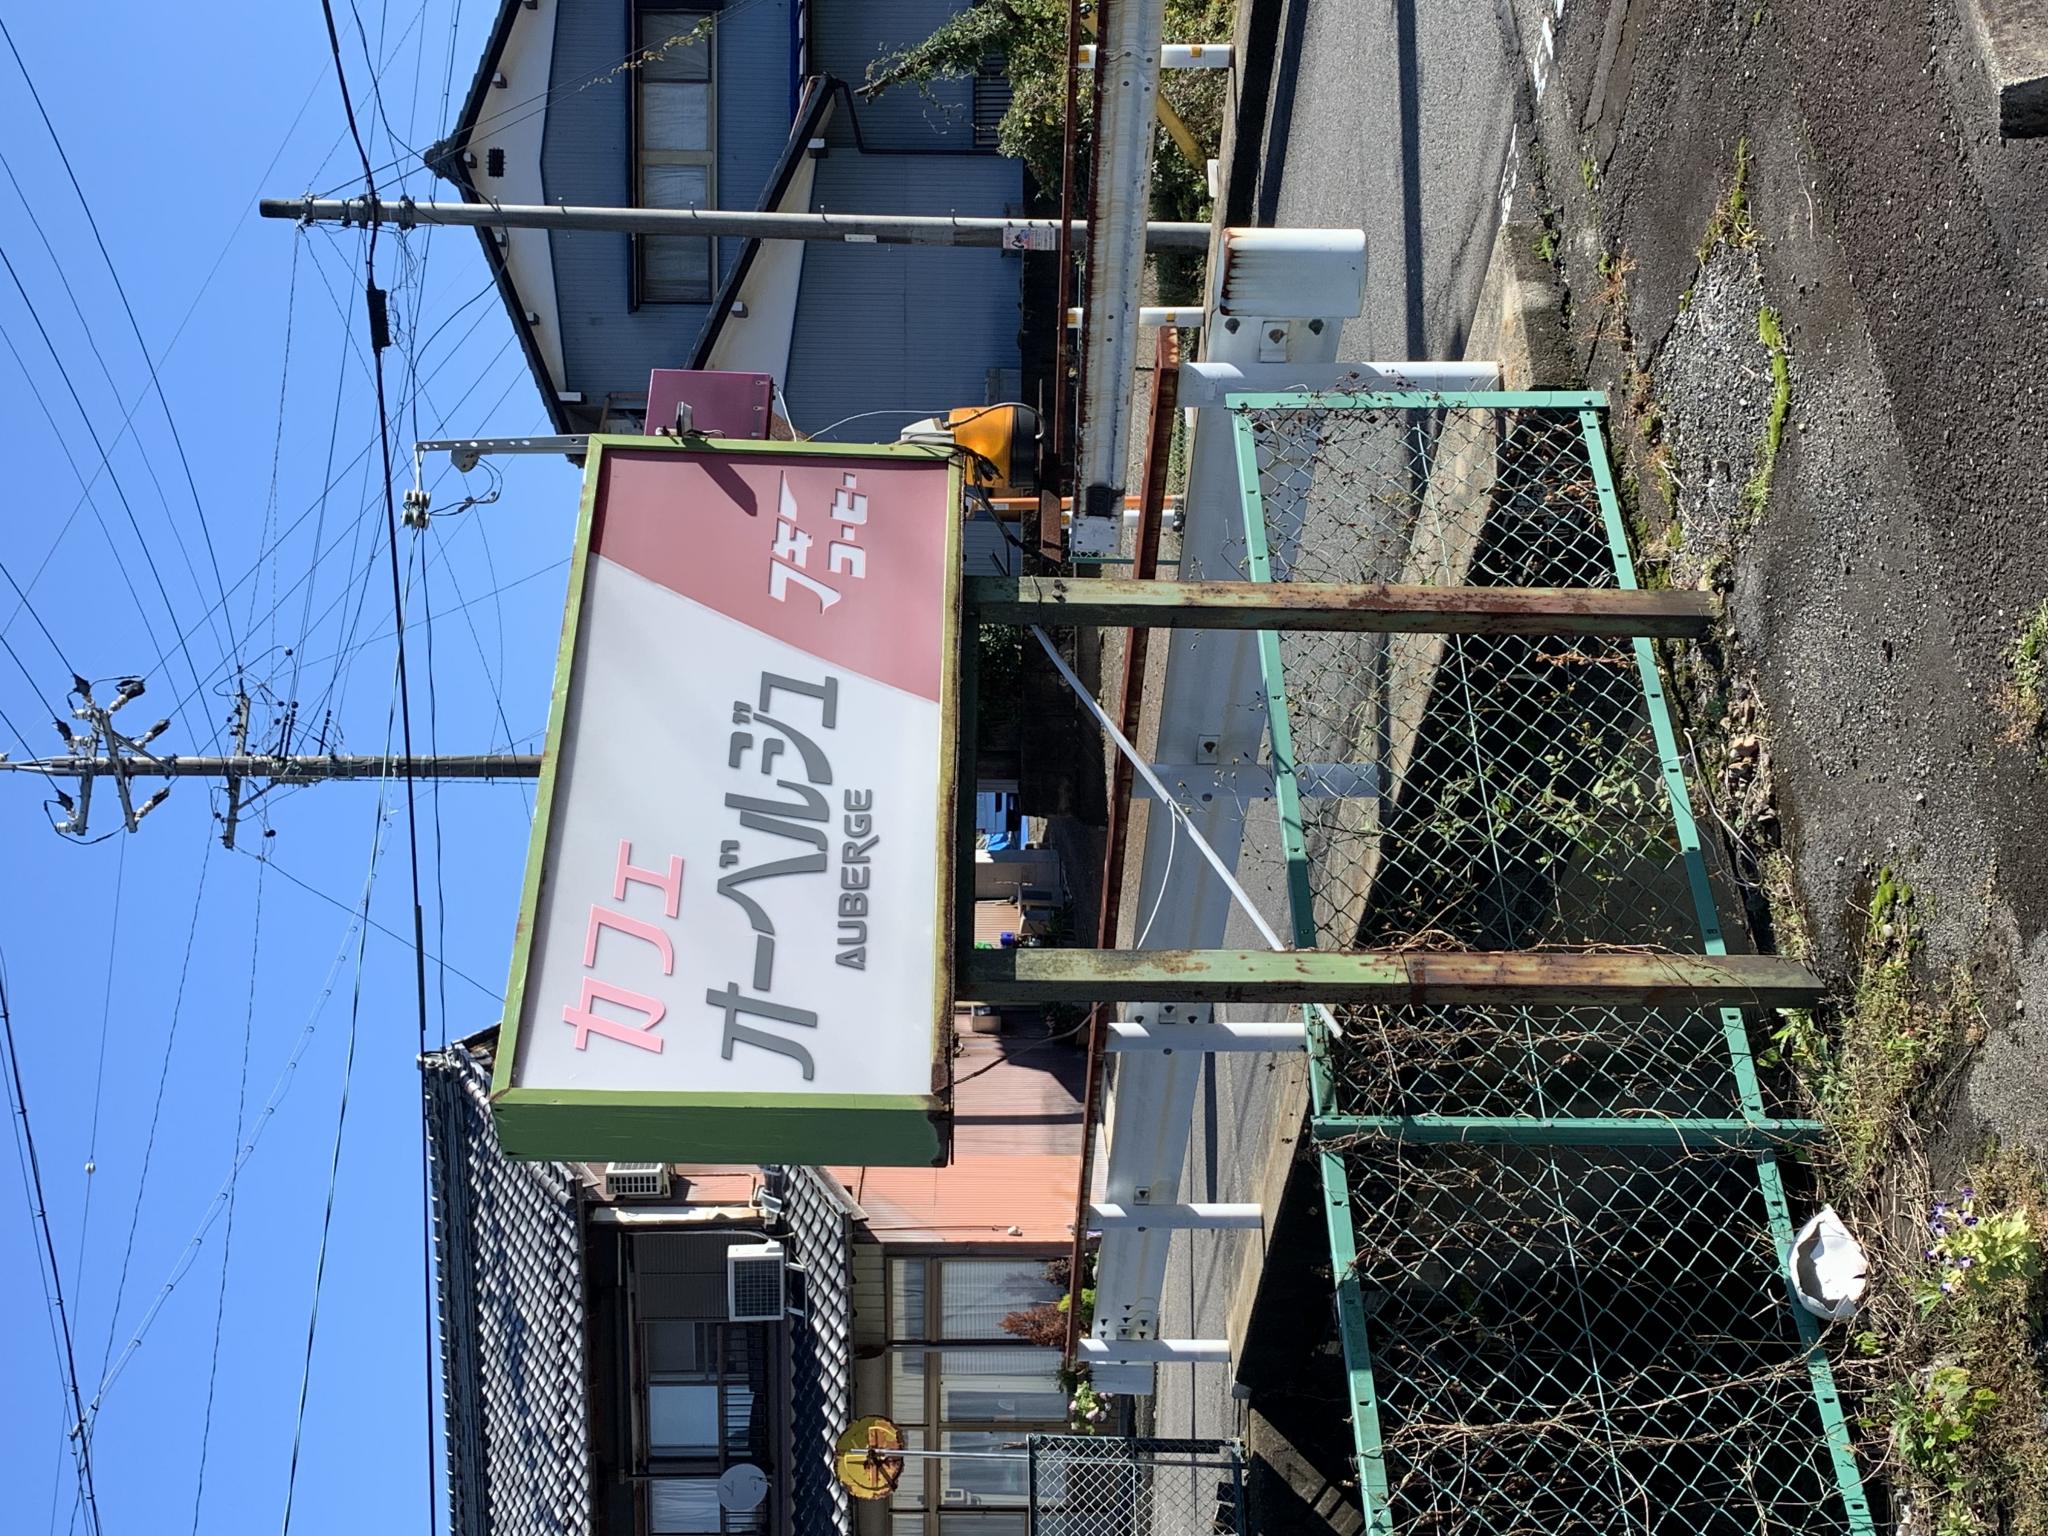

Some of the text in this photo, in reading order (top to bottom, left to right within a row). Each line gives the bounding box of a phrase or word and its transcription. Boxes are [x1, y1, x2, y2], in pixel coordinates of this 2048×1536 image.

[827, 472, 870, 580] コーヒー
[563, 840, 683, 1053] カフェ
[706, 673, 837, 1080] オーベルジュ
[834, 788, 880, 970] AUBERGE
